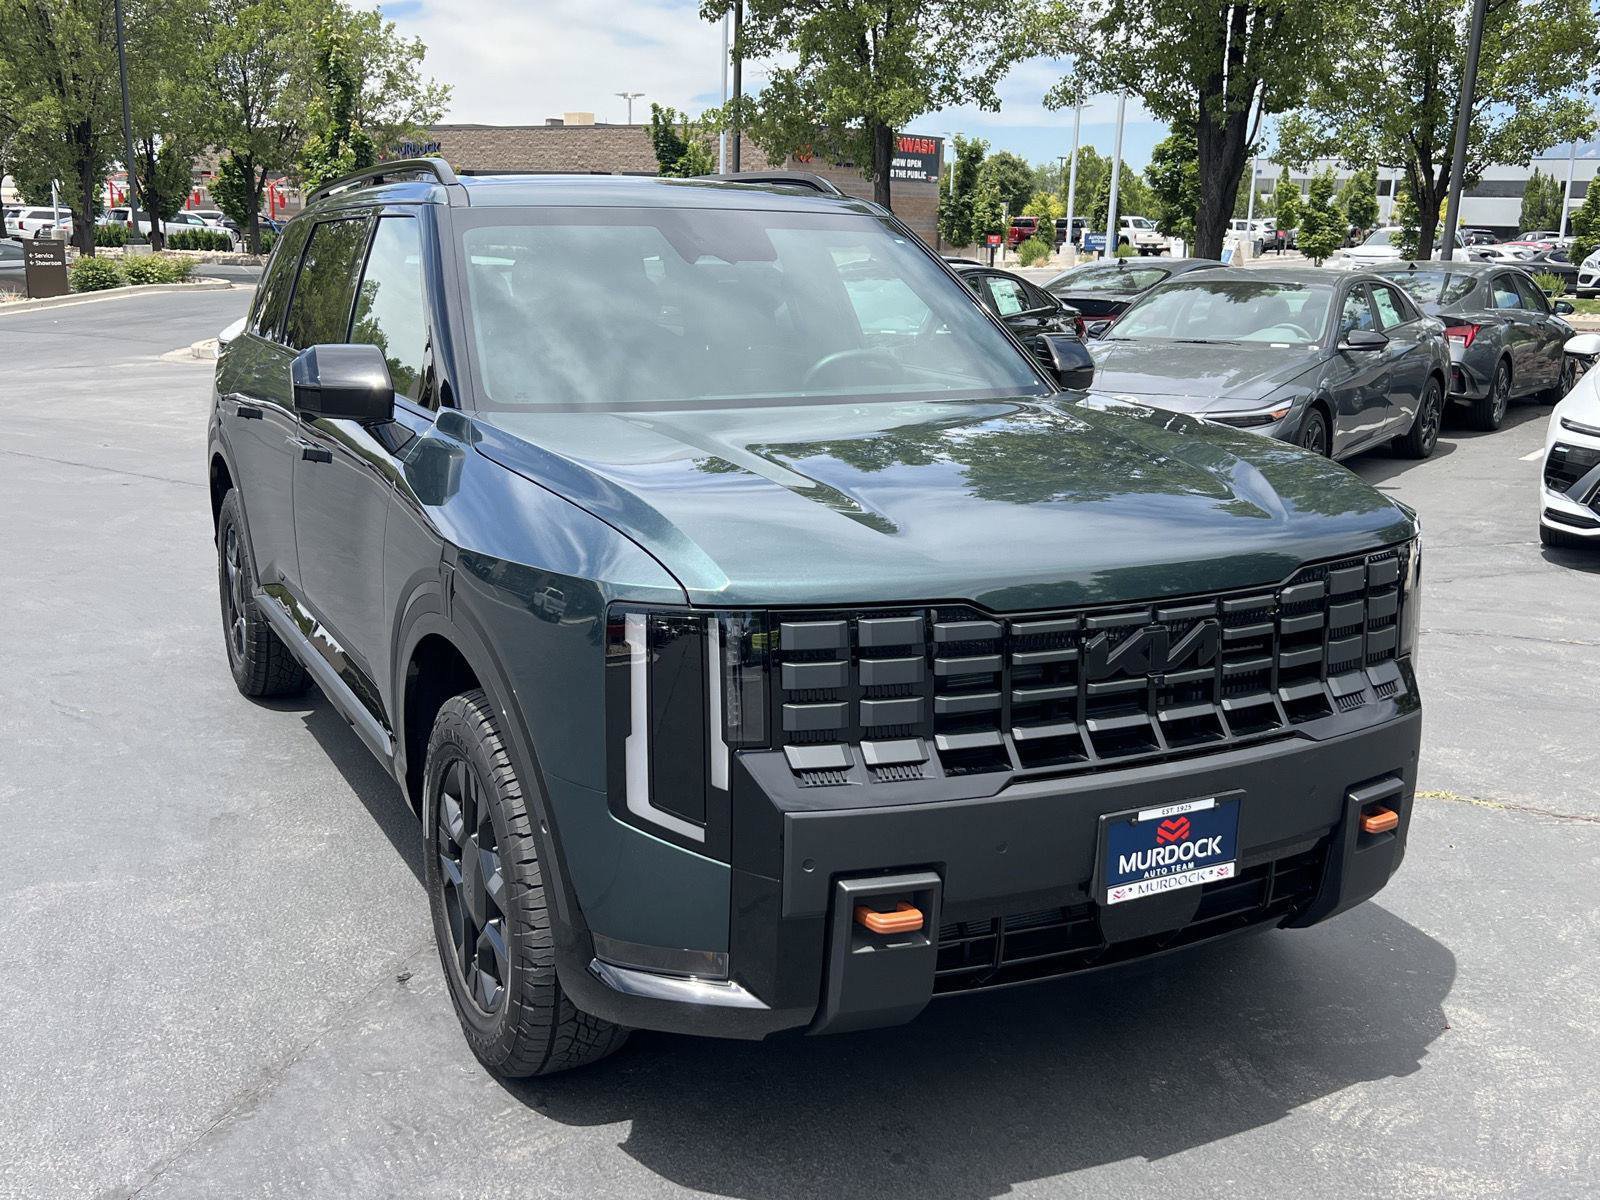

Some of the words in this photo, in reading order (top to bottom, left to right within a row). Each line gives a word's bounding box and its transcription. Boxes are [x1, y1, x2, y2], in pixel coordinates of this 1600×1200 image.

[896, 137, 936, 154] RWASH
[907, 160, 922, 168] OPEN
[896, 170, 906, 178] THE
[907, 170, 927, 179] PUBLIC
[1176, 804, 1192, 813] 1925
[1119, 835, 1222, 874] MURDOCK
[1143, 867, 1168, 879] AUTO
[1171, 862, 1195, 874] TEAM
[1137, 870, 1206, 894] MURDOCK
